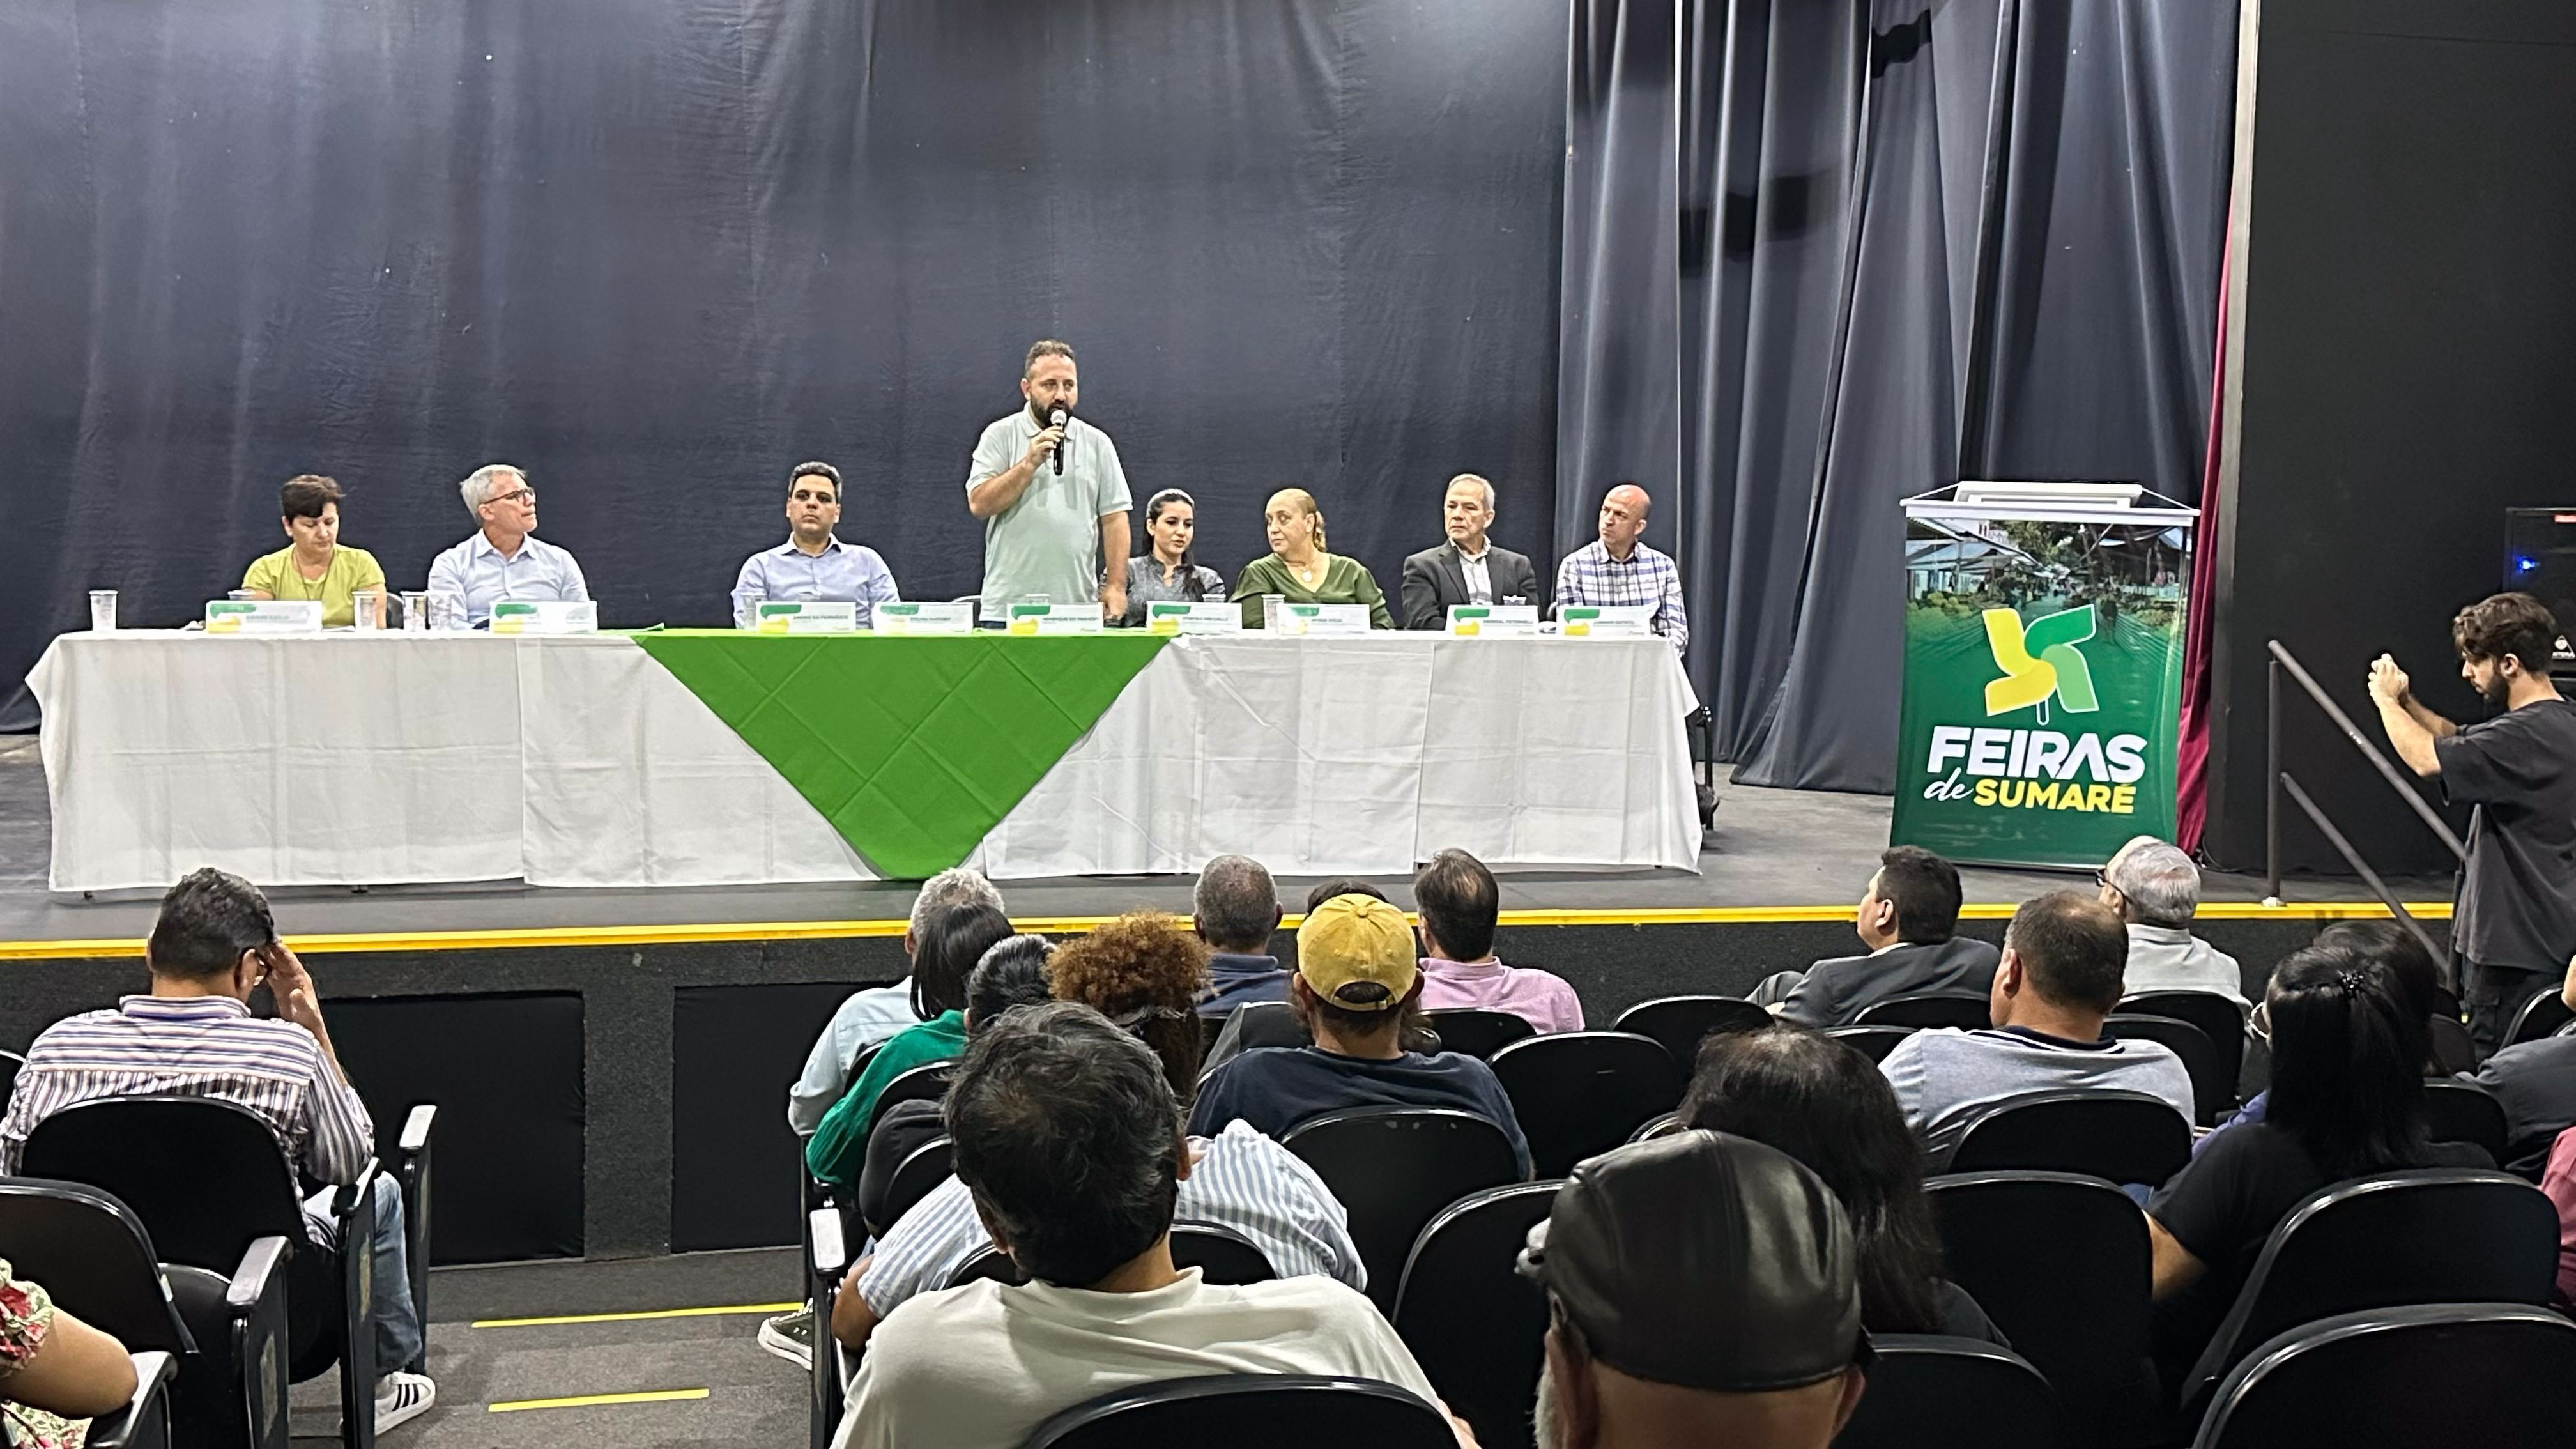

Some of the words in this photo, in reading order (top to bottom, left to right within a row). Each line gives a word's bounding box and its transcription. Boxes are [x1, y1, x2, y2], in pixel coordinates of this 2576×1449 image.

[1927, 726, 2147, 783] FEIRAS
[1923, 767, 1976, 802] de
[1974, 779, 2136, 813] SUMARÉ
